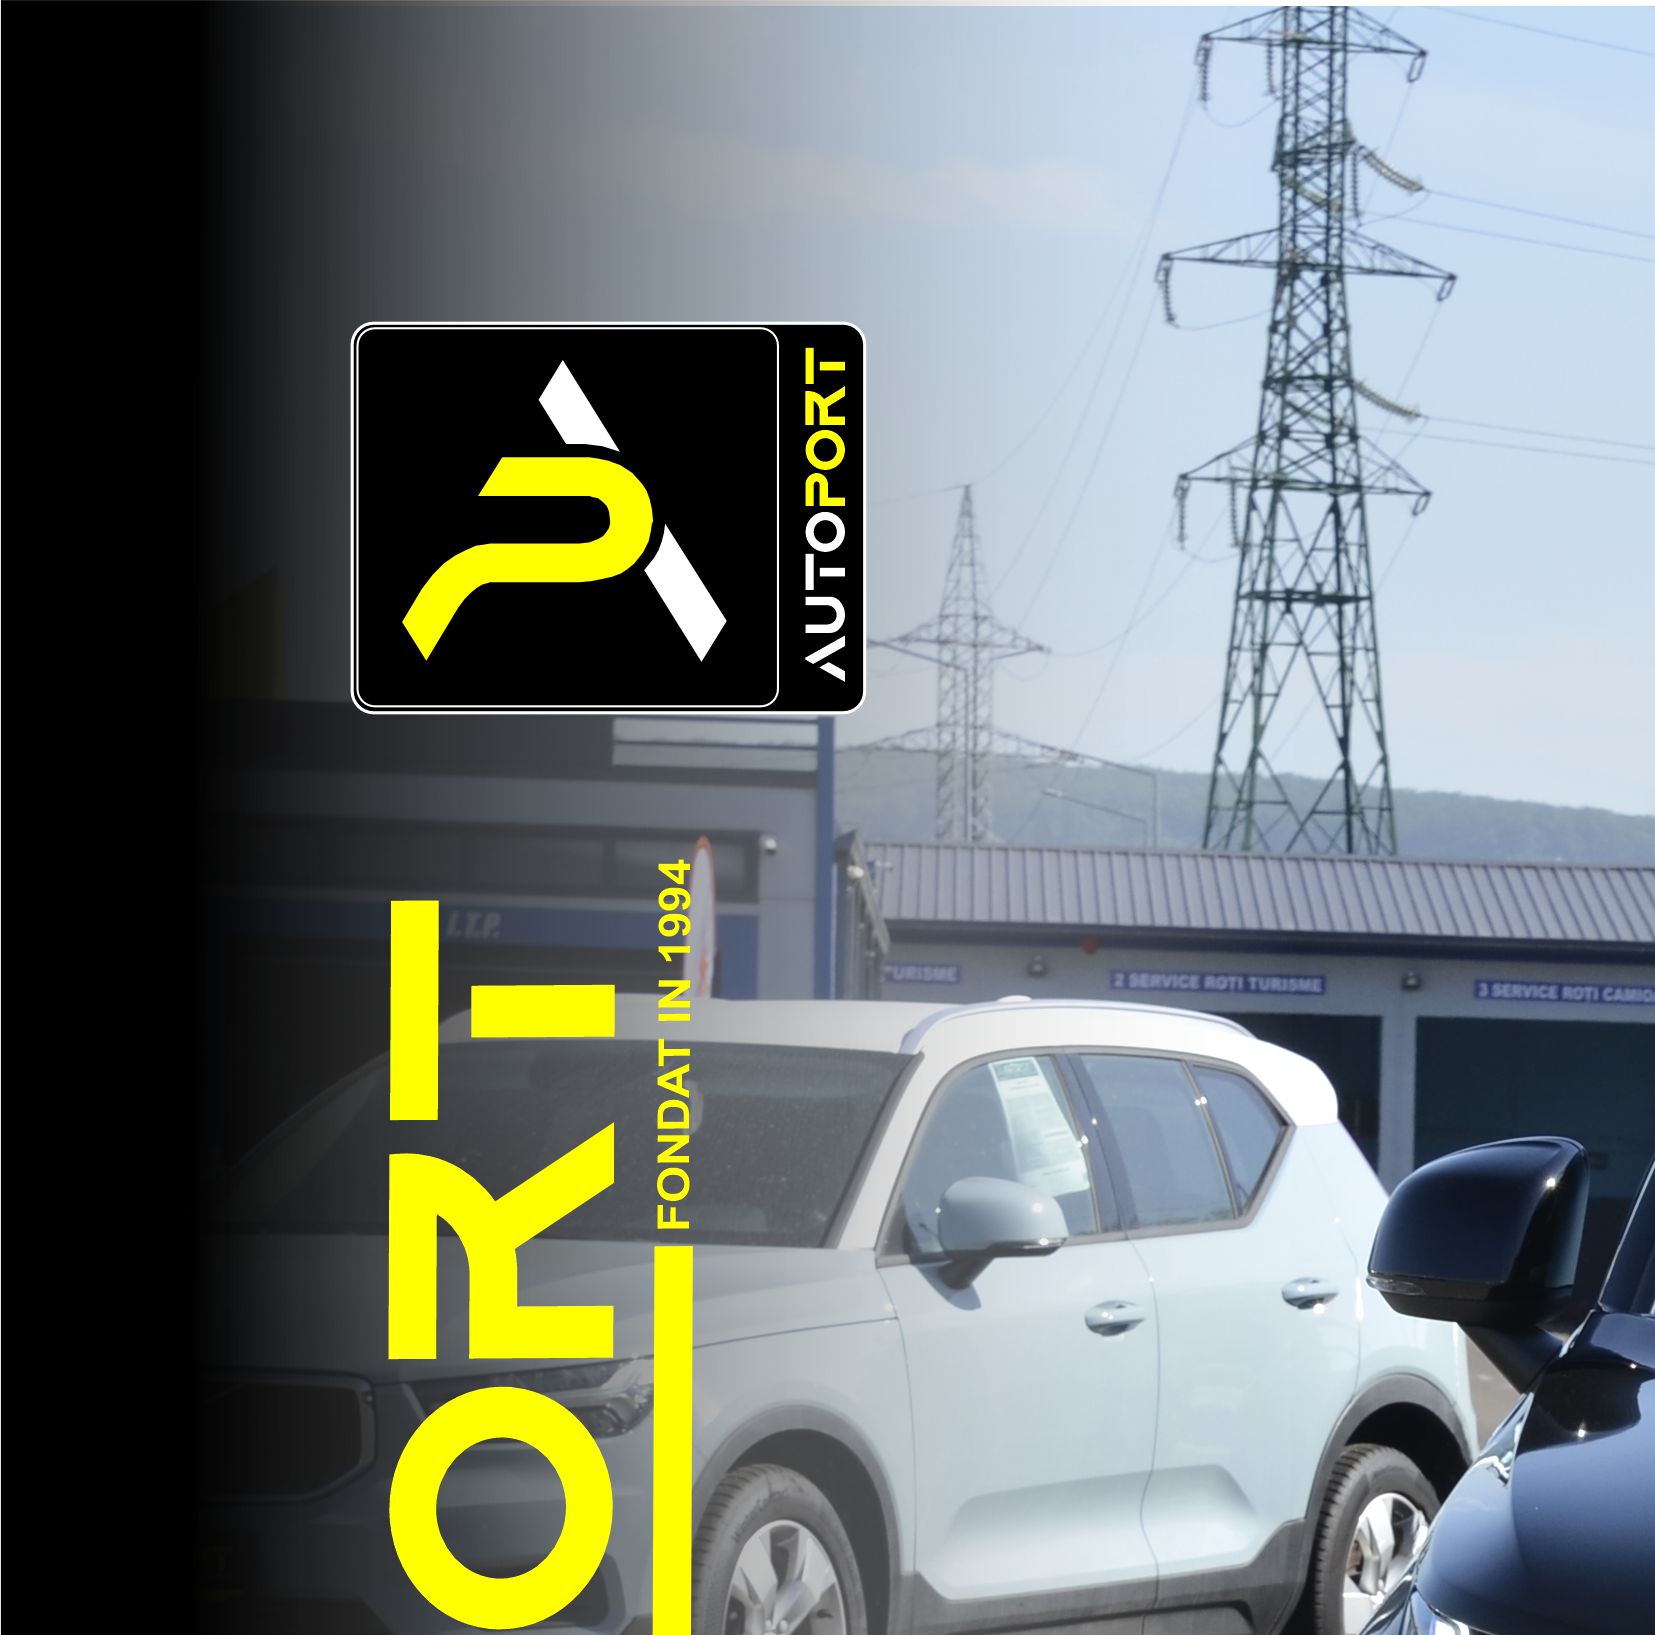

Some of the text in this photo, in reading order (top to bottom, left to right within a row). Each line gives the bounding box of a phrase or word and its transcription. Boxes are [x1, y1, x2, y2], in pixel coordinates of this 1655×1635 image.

[1114, 972, 1126, 988] 2
[1128, 972, 1200, 990] SERVICE
[1247, 976, 1323, 993] TURISME
[1477, 982, 1489, 998] 3
[1491, 982, 1559, 1000] SERVICE
